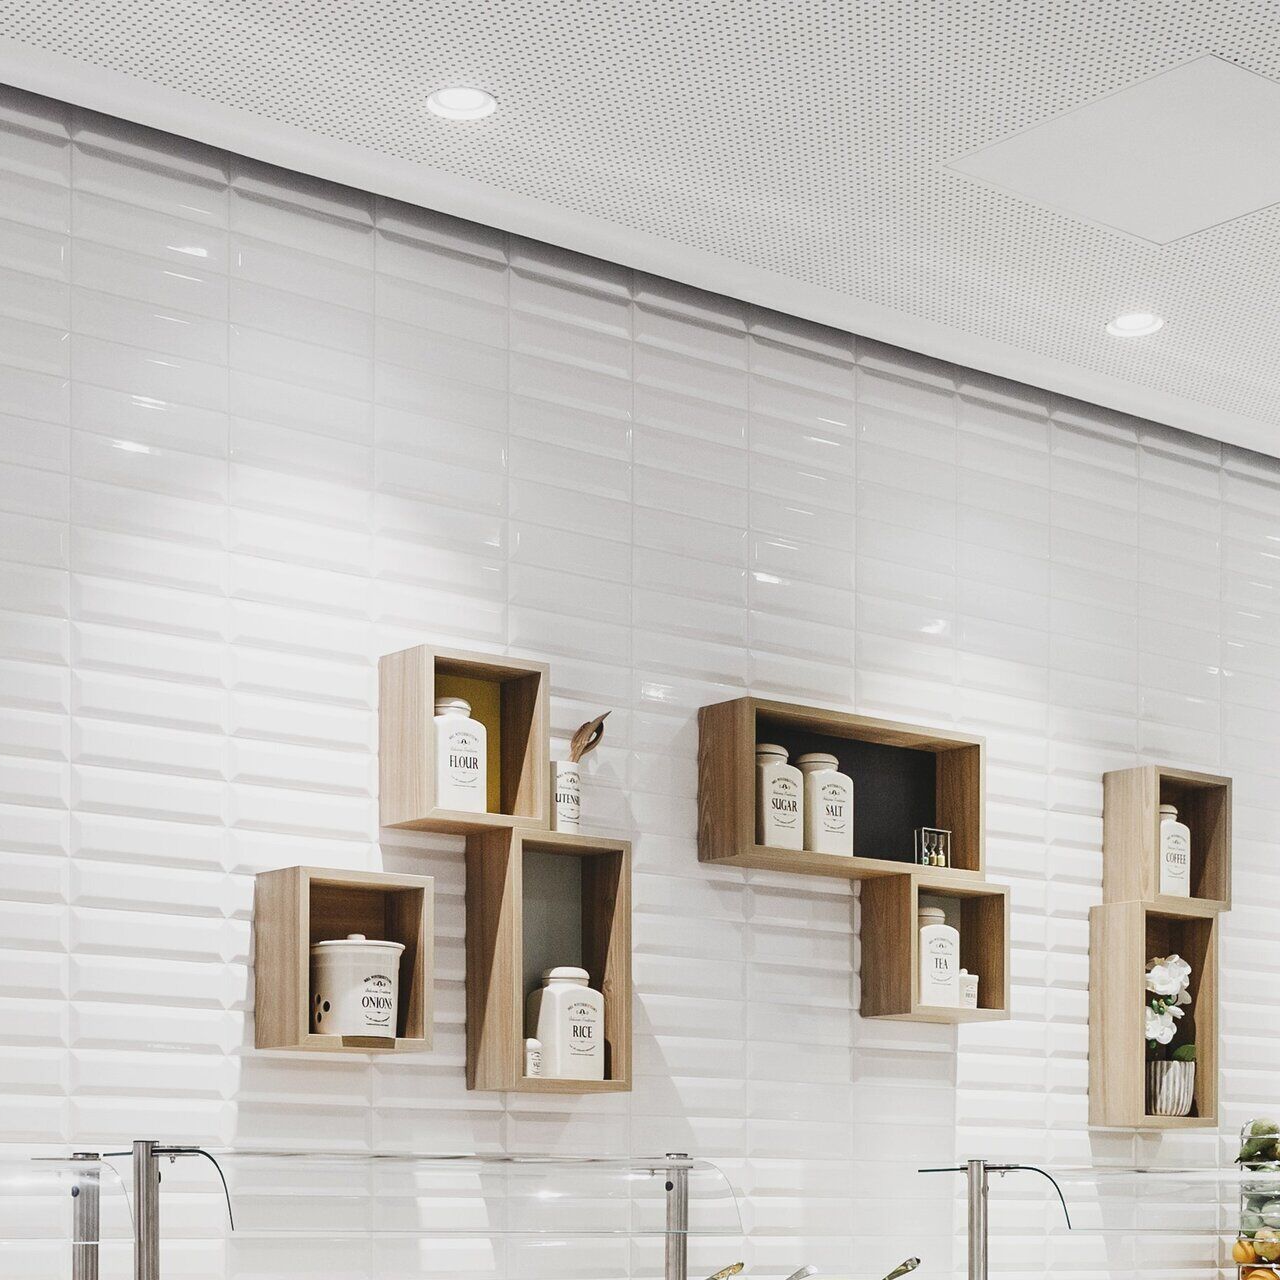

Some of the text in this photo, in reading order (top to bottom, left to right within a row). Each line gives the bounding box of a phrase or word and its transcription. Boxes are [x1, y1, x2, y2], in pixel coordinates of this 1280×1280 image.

[449, 754, 479, 770] FLOUR
[771, 797, 798, 813] SUGAR
[825, 804, 843, 817] SALT
[1165, 852, 1186, 865] COFFEE
[934, 957, 948, 969] TEA
[572, 1024, 593, 1038] RICE
